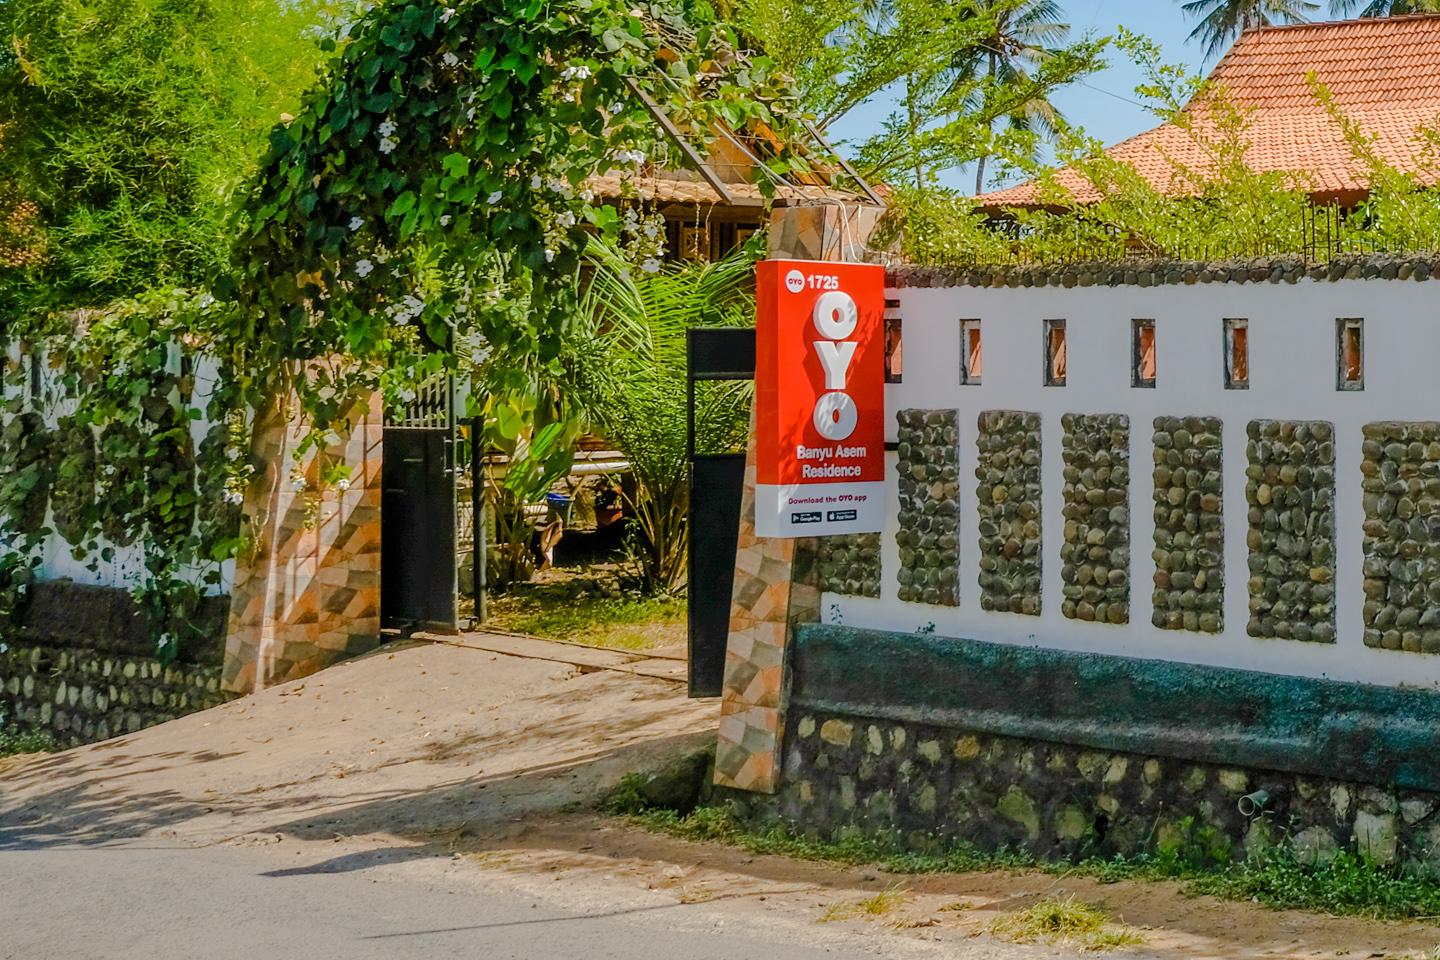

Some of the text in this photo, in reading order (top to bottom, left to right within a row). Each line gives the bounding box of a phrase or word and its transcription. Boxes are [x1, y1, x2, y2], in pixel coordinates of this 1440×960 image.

[807, 275, 838, 290] 1725
[813, 291, 858, 440] OYO
[796, 445, 866, 461] Banyu Asem
[802, 463, 861, 478] Residence
